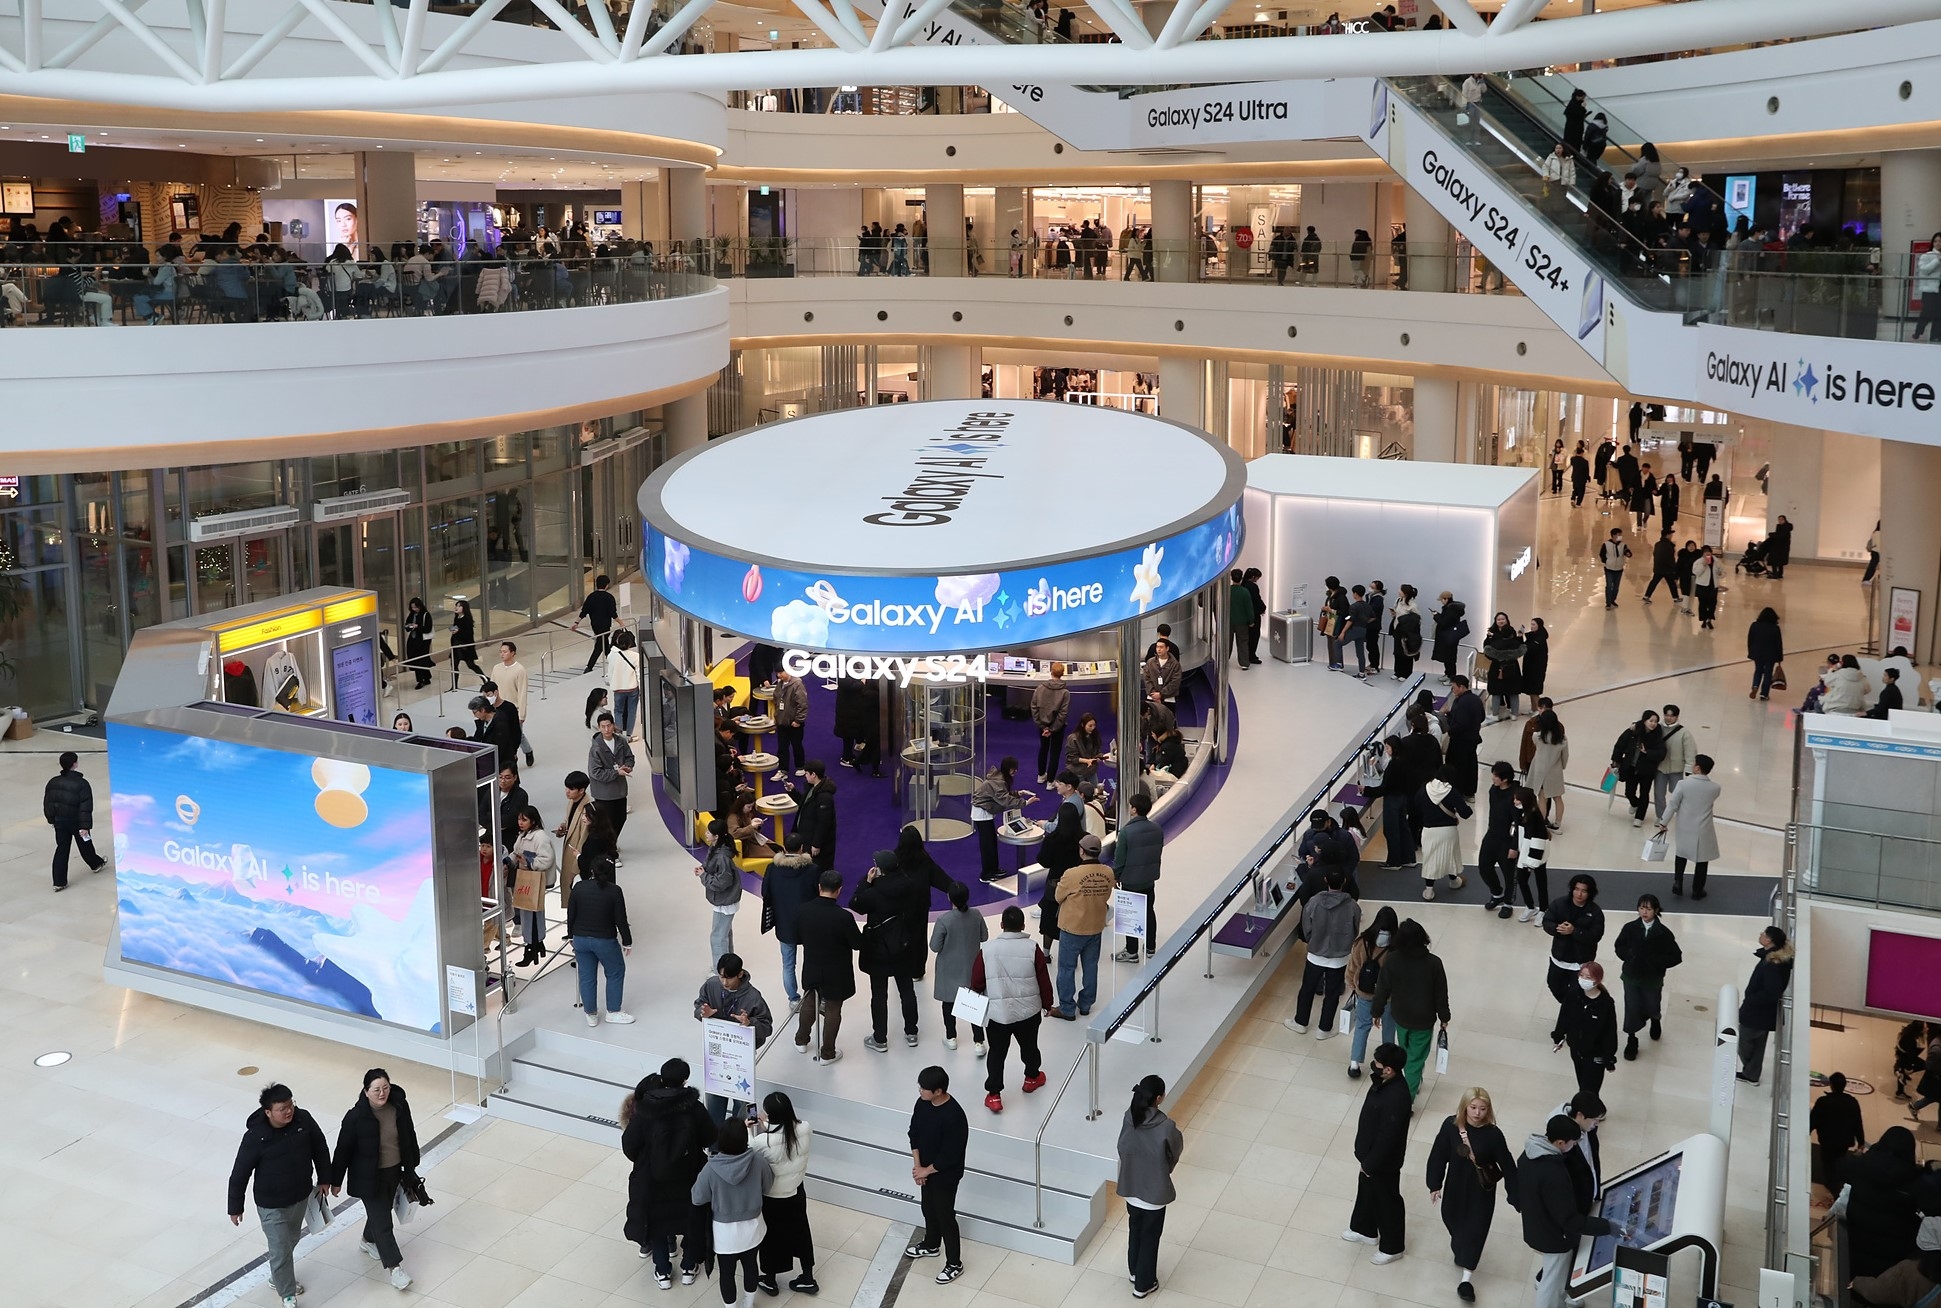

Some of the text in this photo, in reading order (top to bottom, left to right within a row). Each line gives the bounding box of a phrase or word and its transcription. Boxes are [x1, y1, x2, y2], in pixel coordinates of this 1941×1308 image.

[1148, 99, 1288, 129] Galaxy S24 Ultra
[1257, 214, 1266, 263] SALE
[1423, 151, 1569, 292] Galaxy S24 S24+
[1707, 351, 1935, 411] Galaxy AI is here
[862, 412, 1015, 526] Galaxy AI is here
[262, 625, 281, 634] Fashion
[825, 583, 1103, 634] Galaxy AI is here
[782, 649, 989, 688] Galaxy S24
[302, 865, 320, 891] is
[326, 872, 381, 899] here
